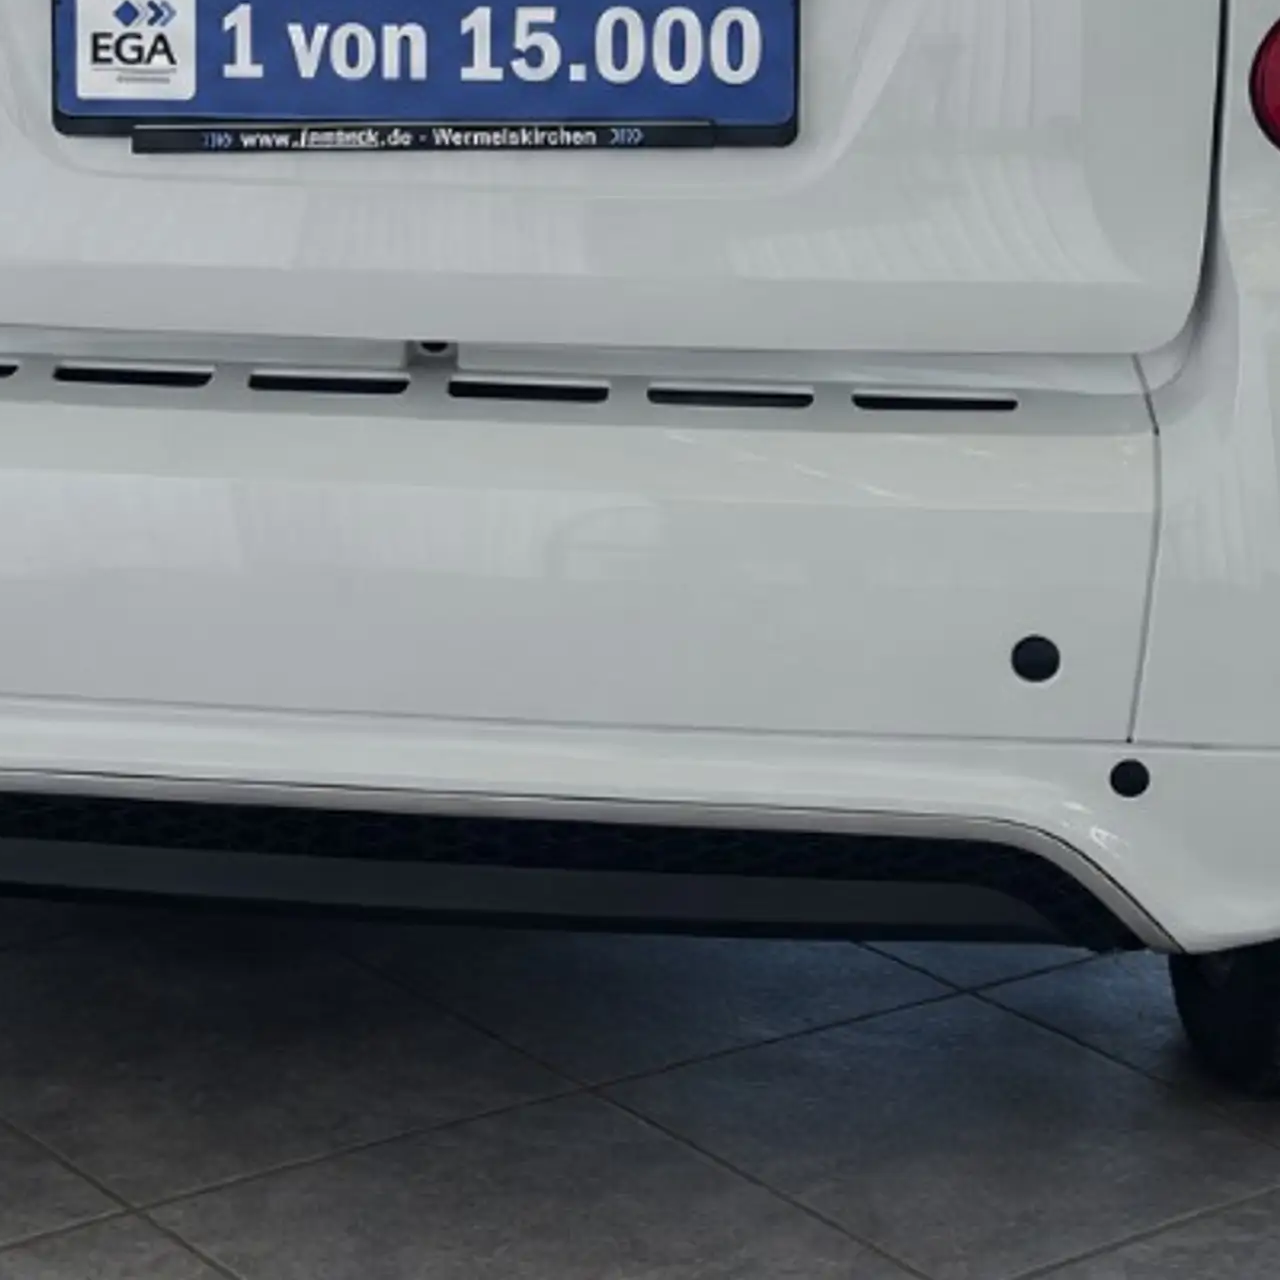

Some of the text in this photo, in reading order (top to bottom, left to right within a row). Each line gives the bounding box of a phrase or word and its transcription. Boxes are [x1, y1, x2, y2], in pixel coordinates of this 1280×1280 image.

[90, 31, 177, 65] EGA
[221, 3, 763, 85] 1 von 15.000
[432, 127, 597, 147] Wermelskirchen
